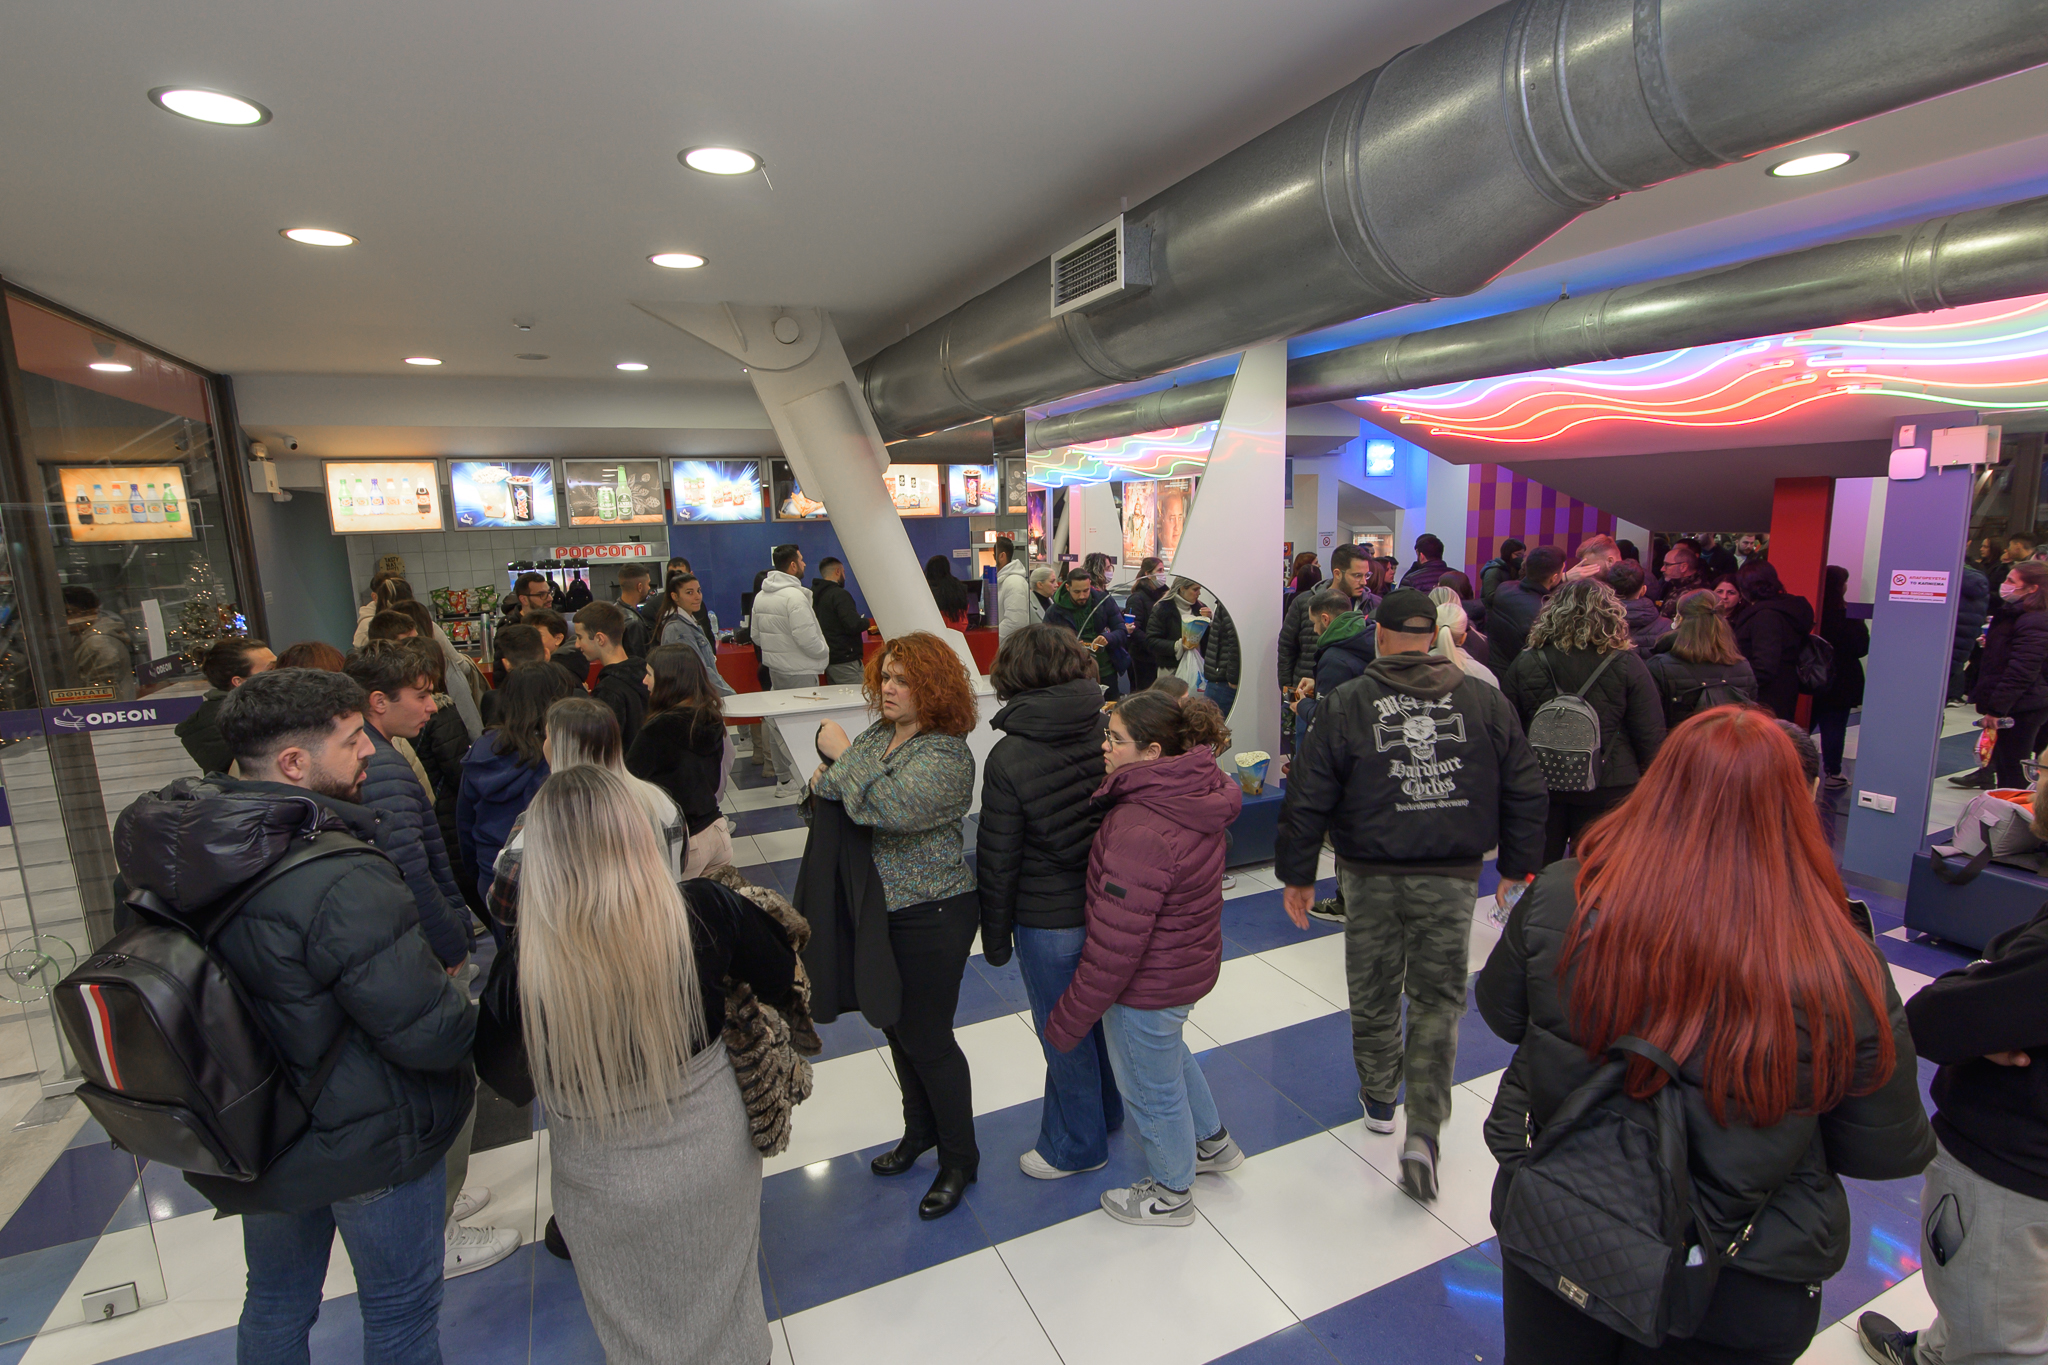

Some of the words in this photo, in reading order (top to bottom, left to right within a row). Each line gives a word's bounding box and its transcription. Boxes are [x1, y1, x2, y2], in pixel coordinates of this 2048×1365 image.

[57, 689, 108, 698] ΩΘΗΣΑΤΕ
[86, 708, 157, 725] ODEON
[1387, 756, 1464, 779] Hardcore
